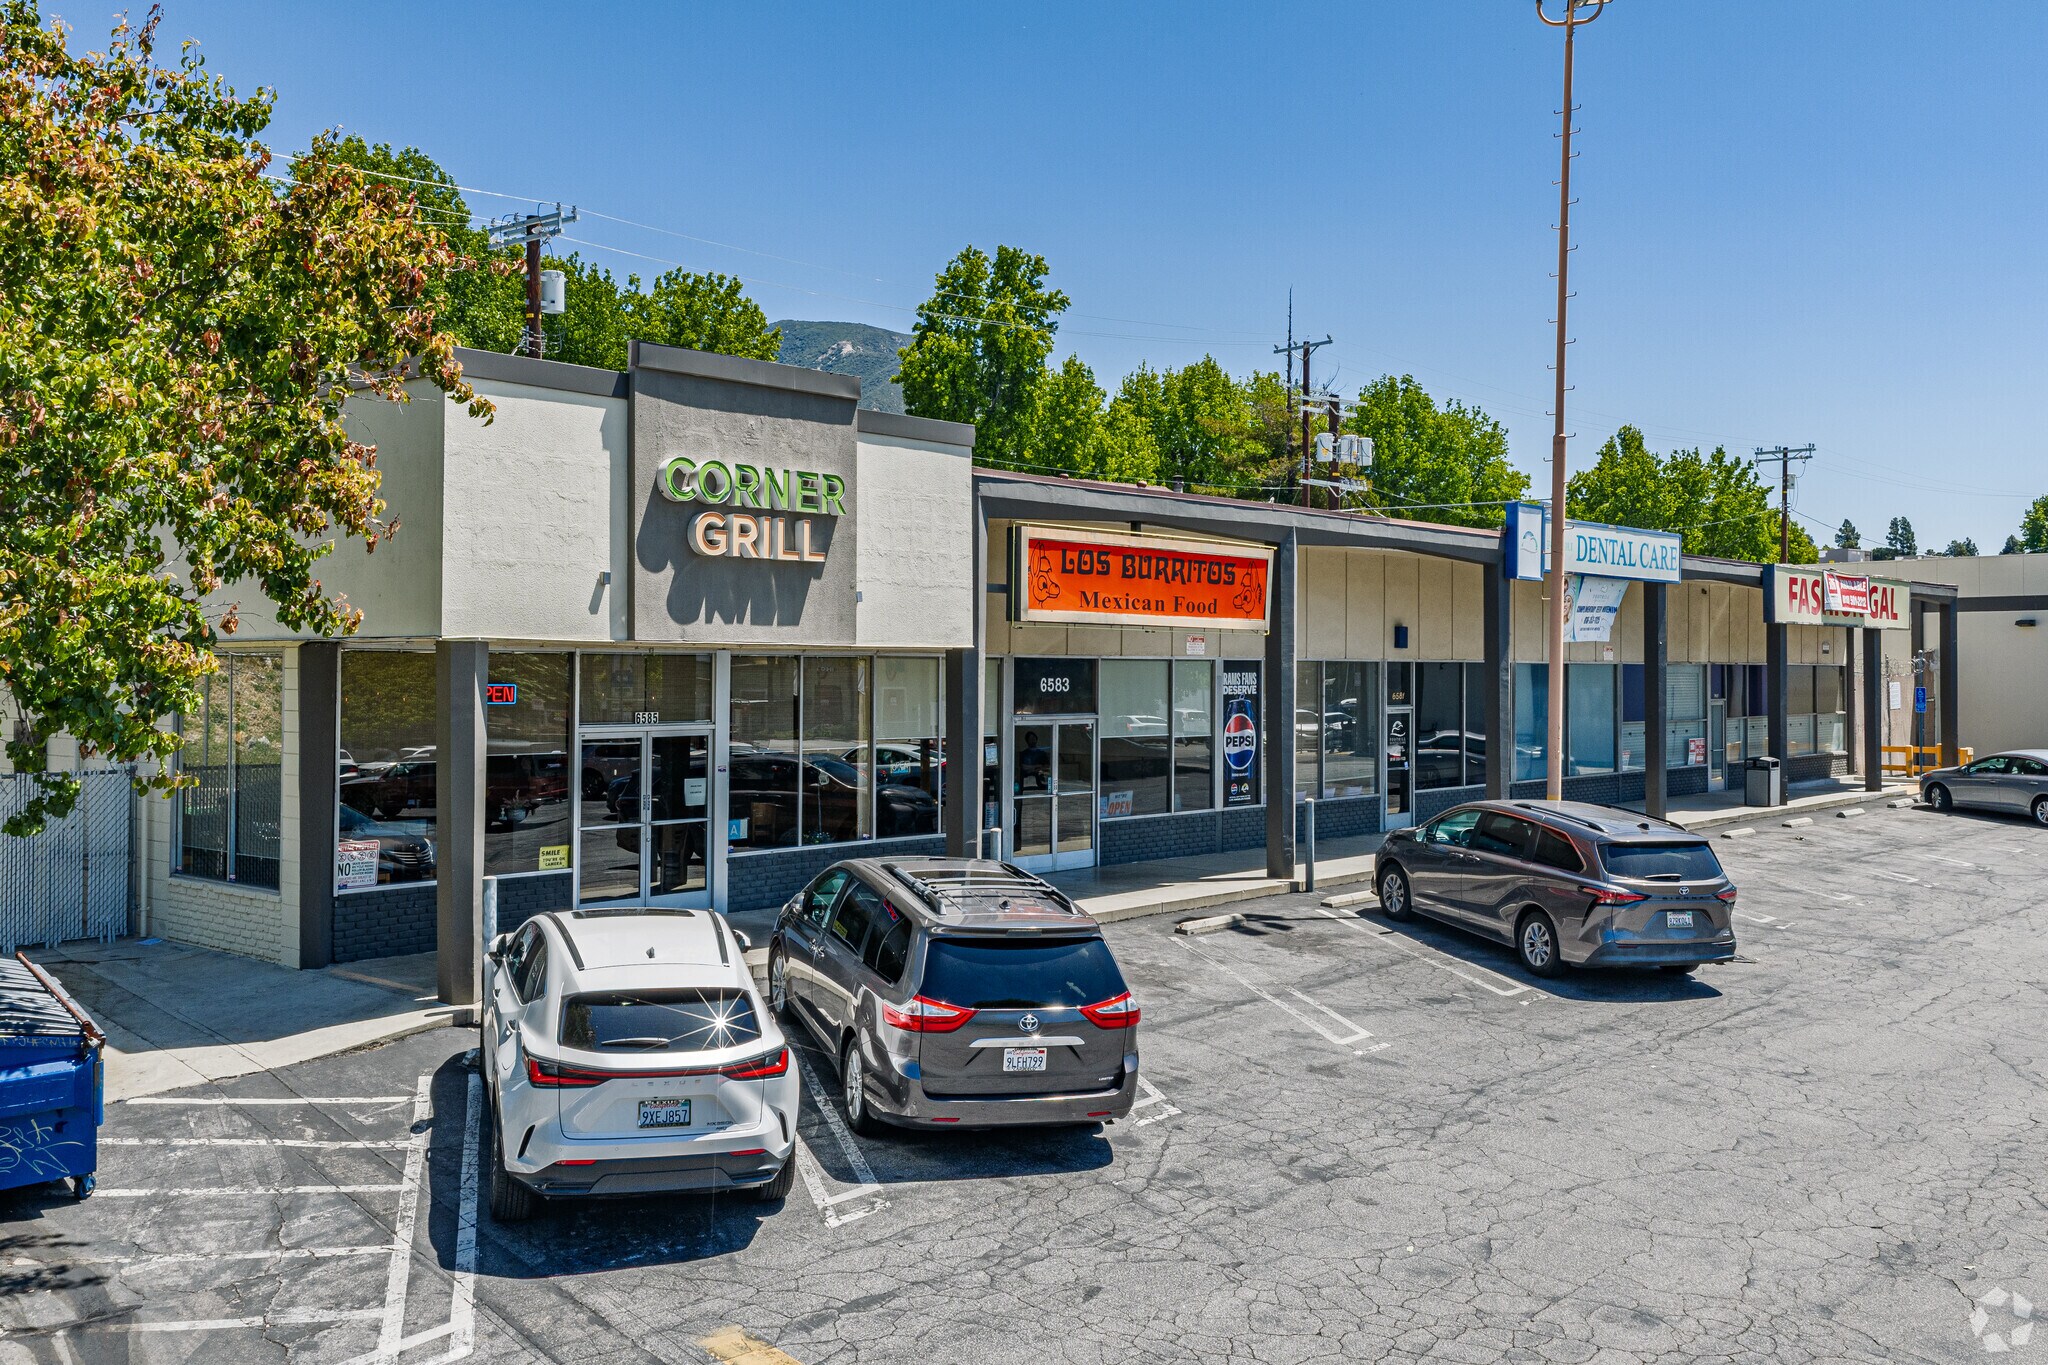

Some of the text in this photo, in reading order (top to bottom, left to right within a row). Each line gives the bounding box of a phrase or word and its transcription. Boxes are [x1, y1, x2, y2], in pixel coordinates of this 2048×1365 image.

[656, 456, 847, 516] CORNER
[687, 511, 826, 562] GRILL
[1576, 535, 1678, 572] DENTAL CARE
[1061, 549, 1236, 585] LOS BURRITOS
[1079, 590, 1218, 615] Mexican Food
[1869, 585, 1898, 621] GAL
[1040, 677, 1070, 693] 6583
[1223, 672, 1257, 686] RAMS FANS
[487, 686, 514, 702] PEN
[1223, 685, 1257, 695] DESERVE
[636, 712, 658, 724] 6585
[1225, 736, 1254, 748] PEPSI
[1108, 801, 1131, 815] OPEN
[730, 824, 739, 836] A
[337, 862, 351, 876] NO
[642, 1110, 688, 1124] 9XEJ857
